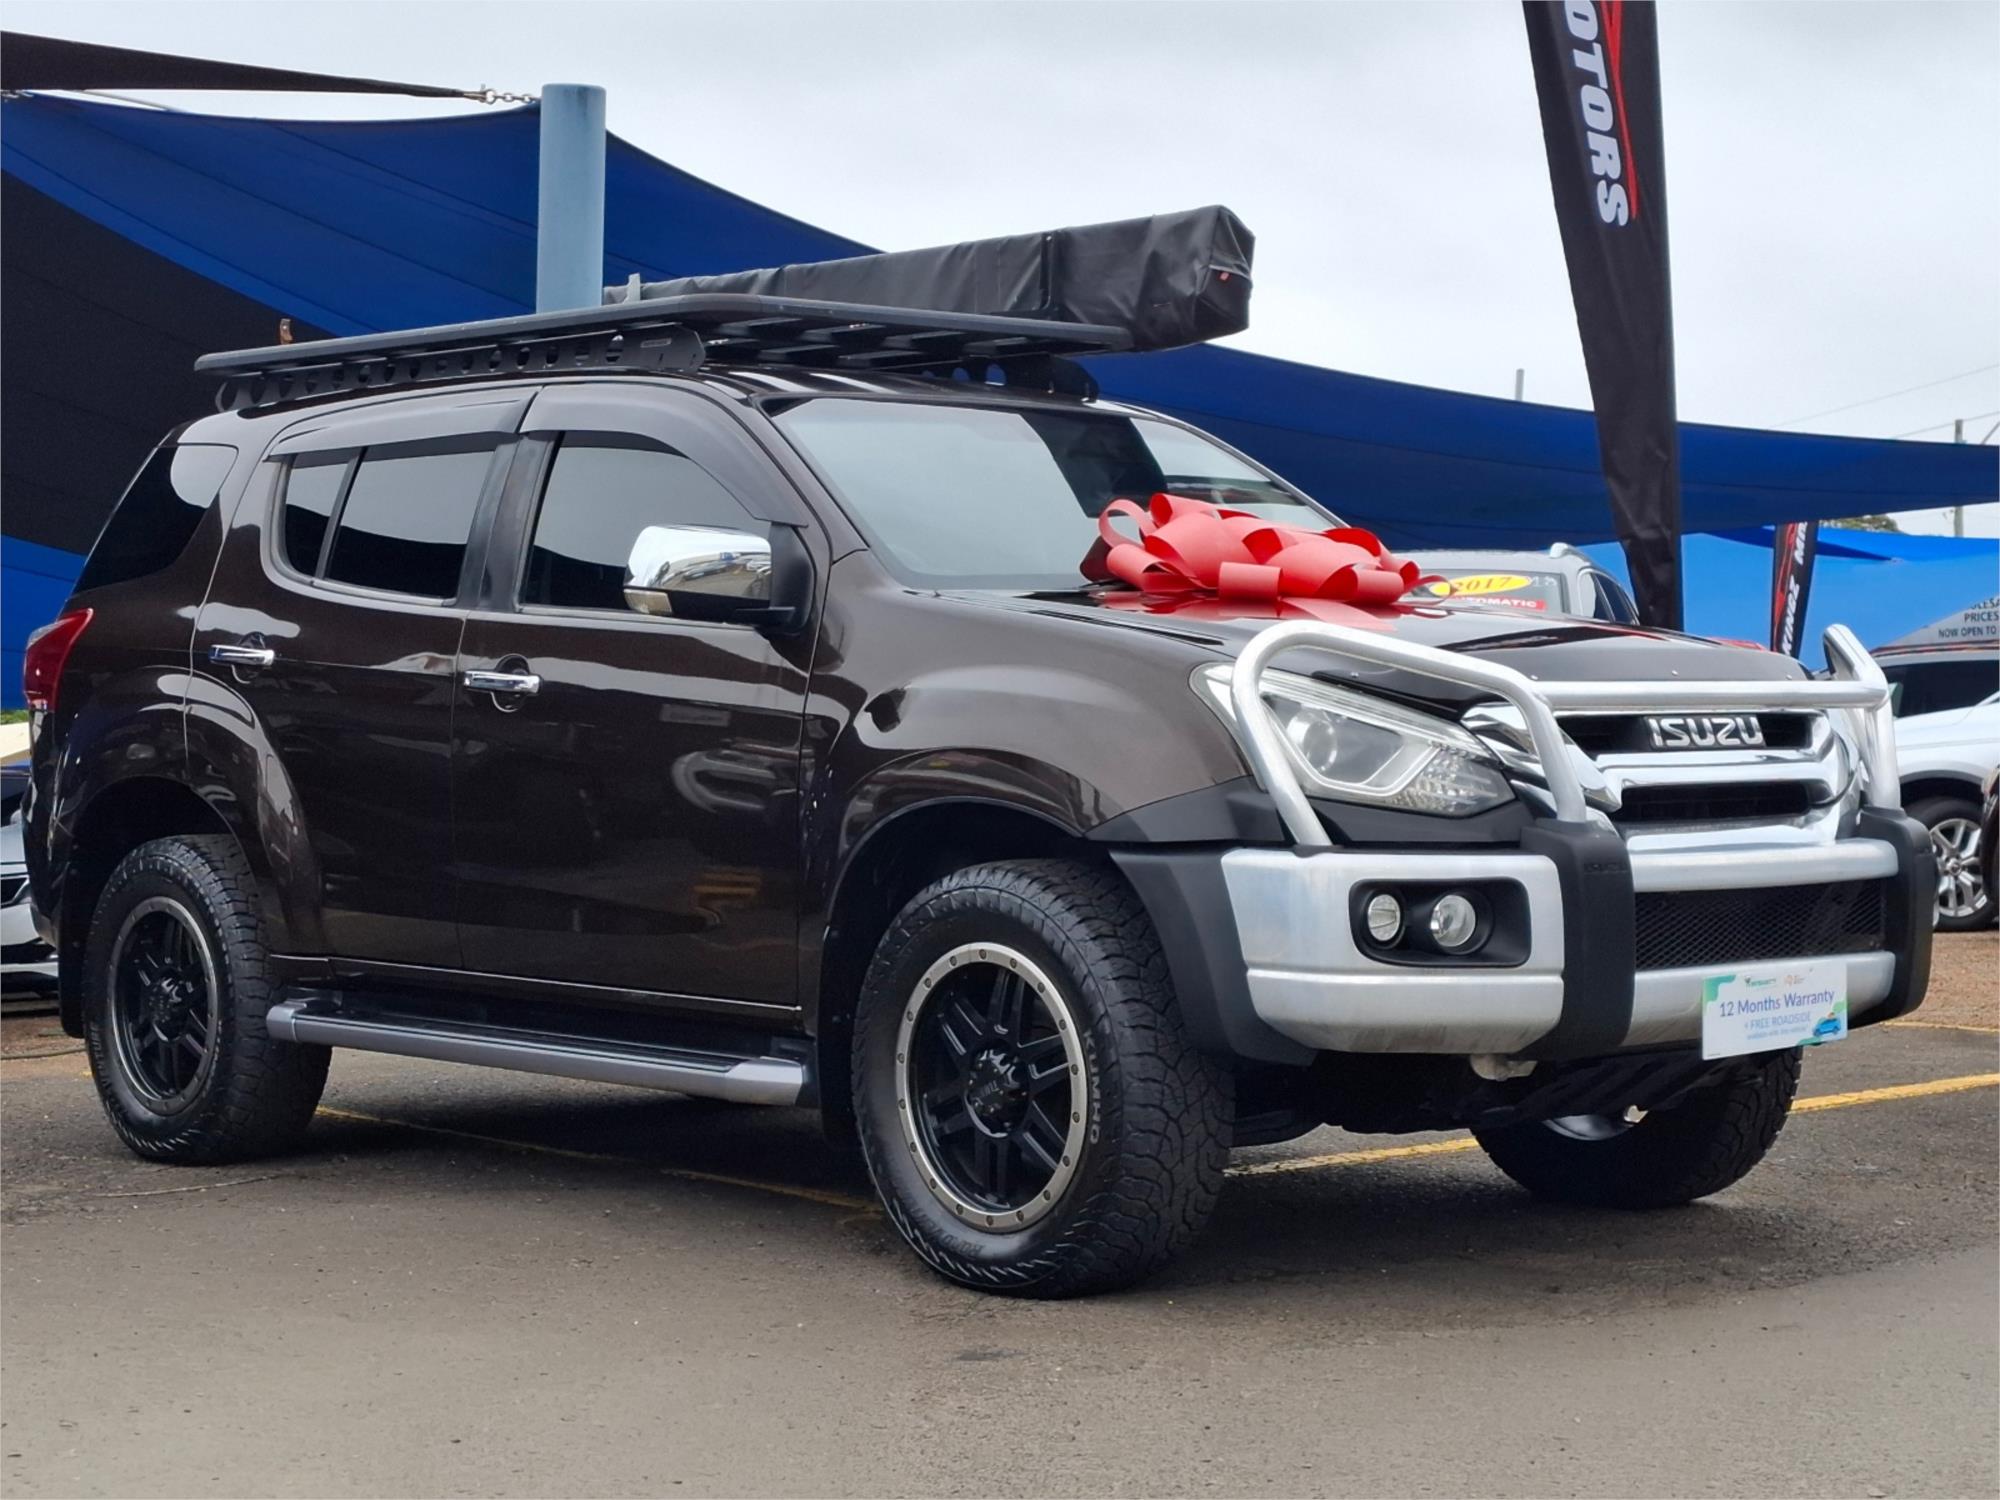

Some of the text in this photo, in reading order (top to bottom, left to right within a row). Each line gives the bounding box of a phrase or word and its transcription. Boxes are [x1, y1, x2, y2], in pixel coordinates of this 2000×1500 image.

[1564, 0, 1629, 226] OTORS
[1938, 625, 1997, 638] NOW OPEN TO
[1964, 611, 1999, 623] PRICES
[1648, 716, 1764, 747] ISUZU
[1720, 990, 1835, 1017] 12 Months Warranty
[1083, 1029, 1100, 1145] KUMHO
